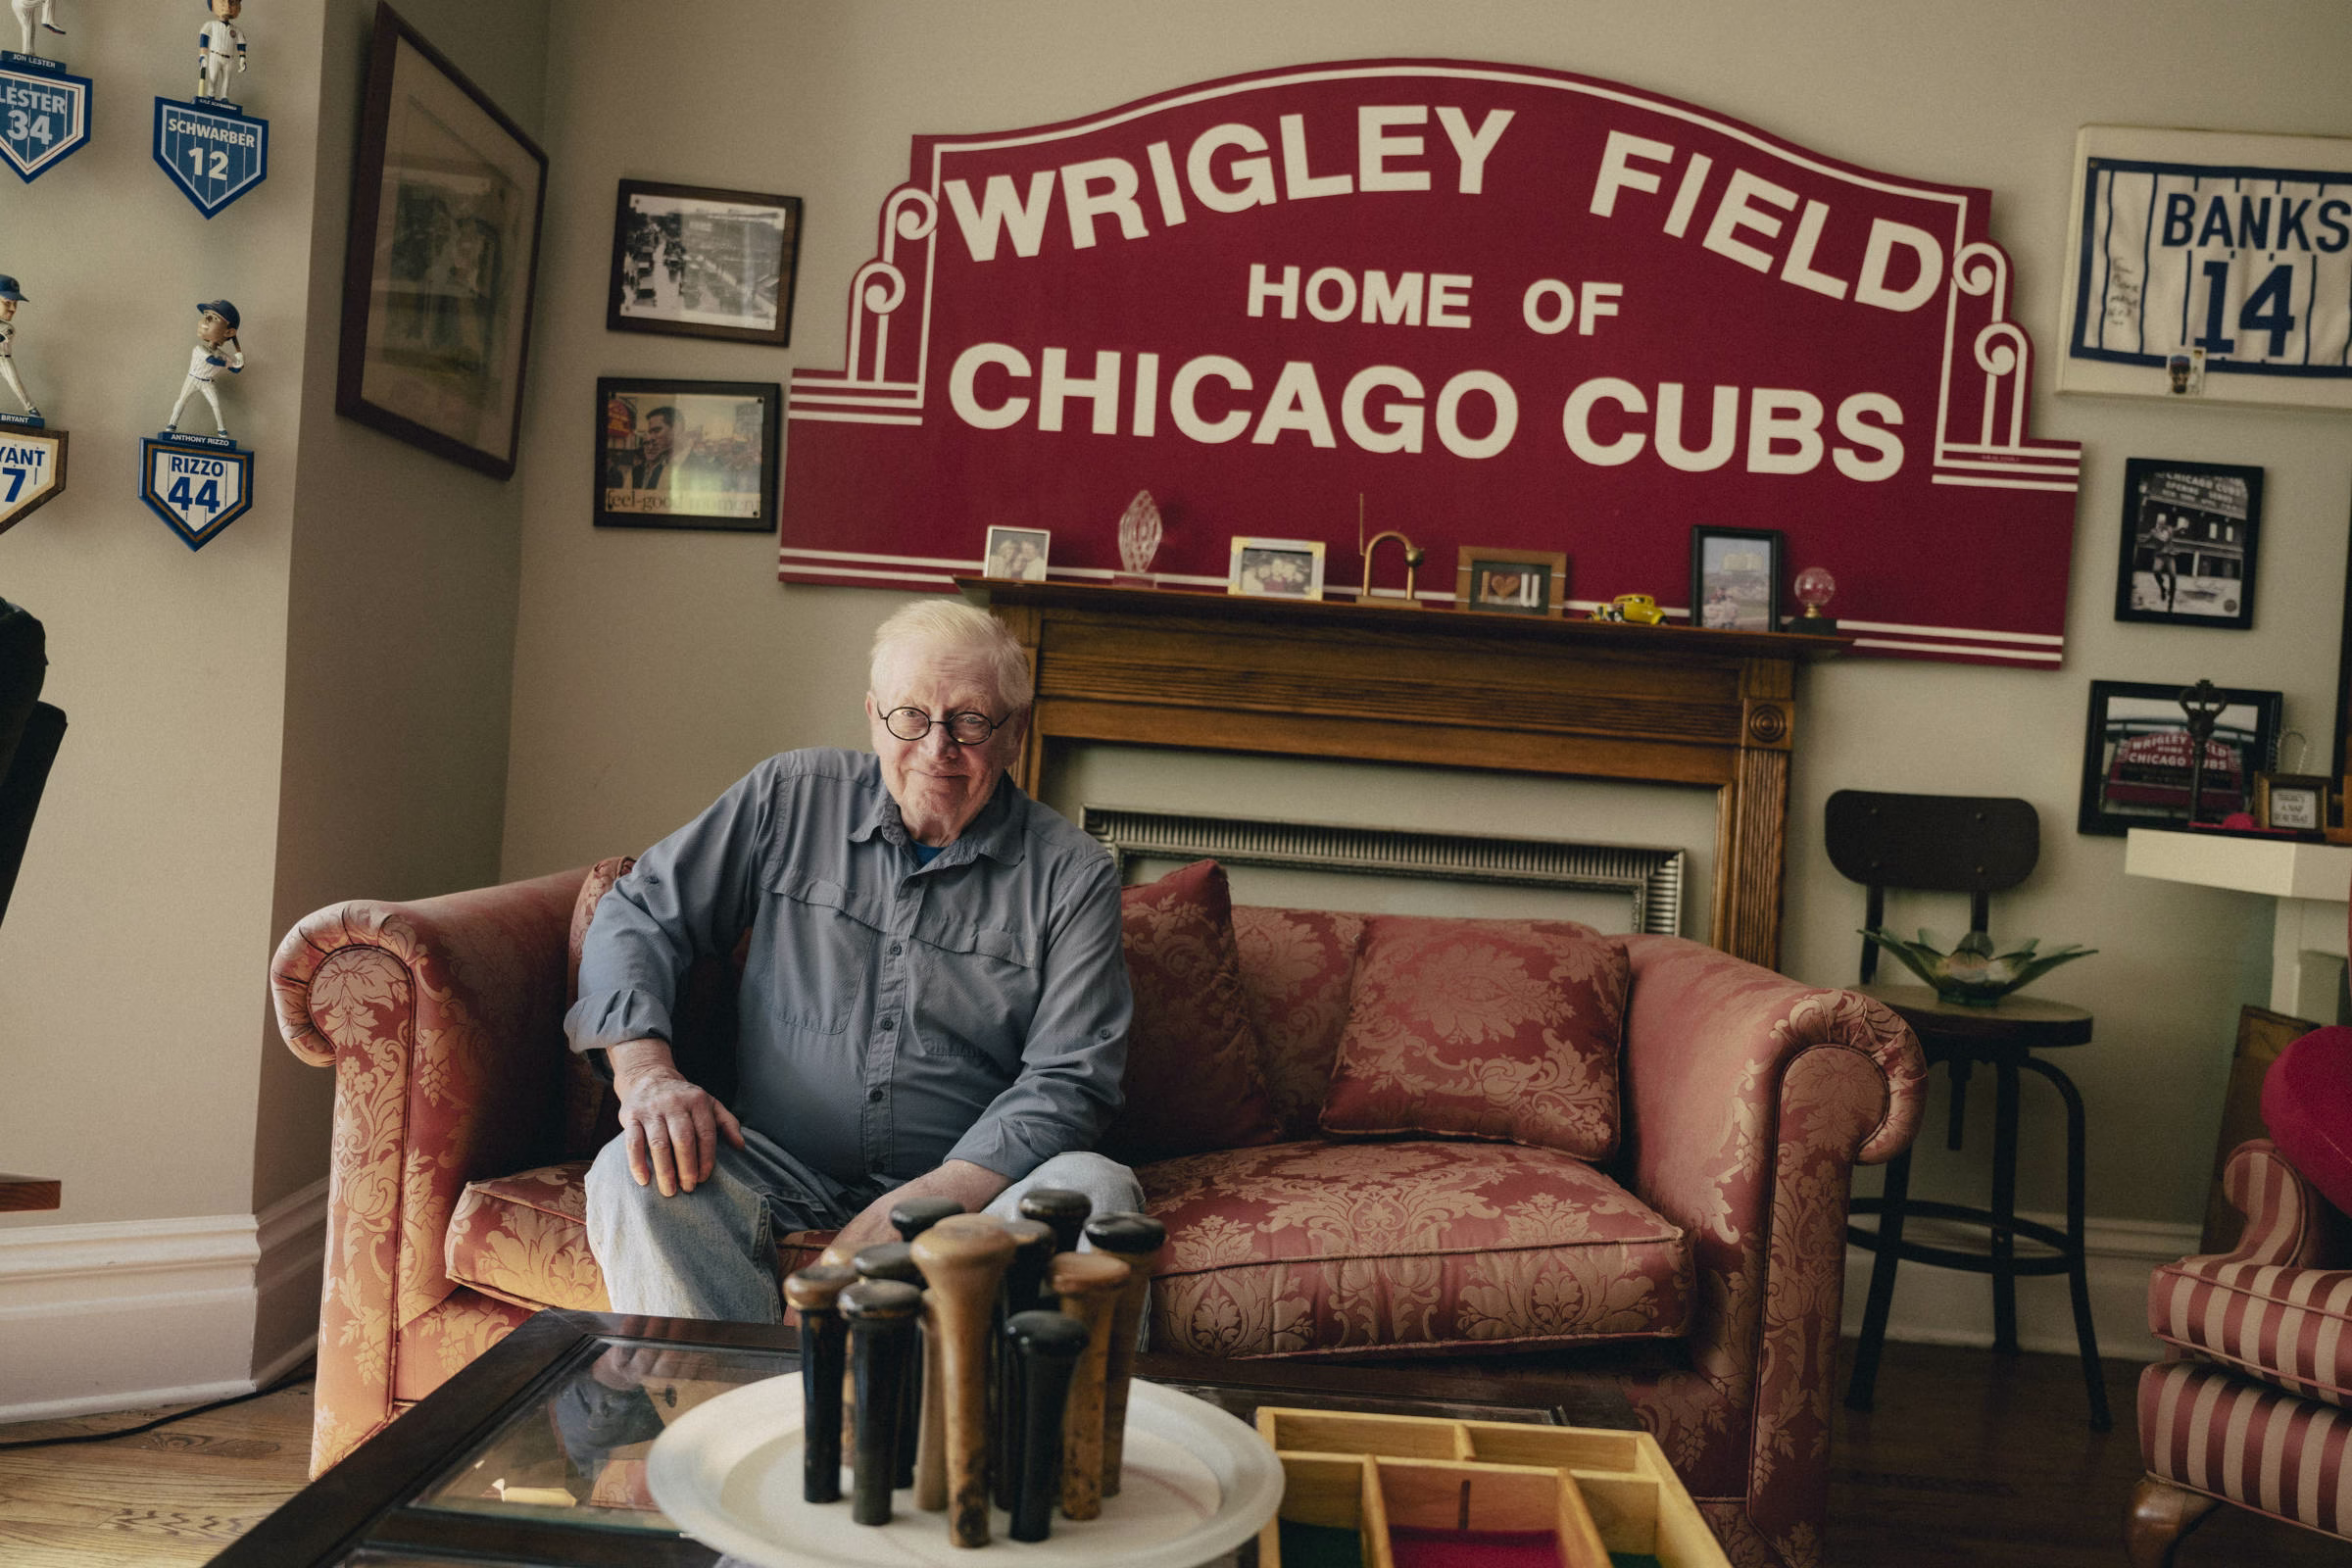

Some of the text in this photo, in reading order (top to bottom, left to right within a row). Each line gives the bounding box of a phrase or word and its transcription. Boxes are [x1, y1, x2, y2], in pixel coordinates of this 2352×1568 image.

[13, 53, 56, 69] JON LESTER
[6, 109, 53, 145] 34
[168, 118, 255, 148] SCHWARBER
[187, 147, 229, 181] 12
[943, 104, 1516, 263] WRIGLEY
[1589, 129, 1944, 313] FIELD
[2161, 192, 2352, 254] BANKS
[1247, 263, 1624, 336] HOME OF
[2193, 260, 2295, 358] 14
[1, 414, 30, 424] BRYANT
[948, 341, 1905, 482] CHICAGO CUBS
[171, 433, 229, 447] ANTHONY RIZZO
[171, 456, 224, 477] RIZZO
[168, 475, 220, 514] 44
[2128, 752, 2187, 767] CHICAGO
[2132, 735, 2188, 751] WRIGLEY
